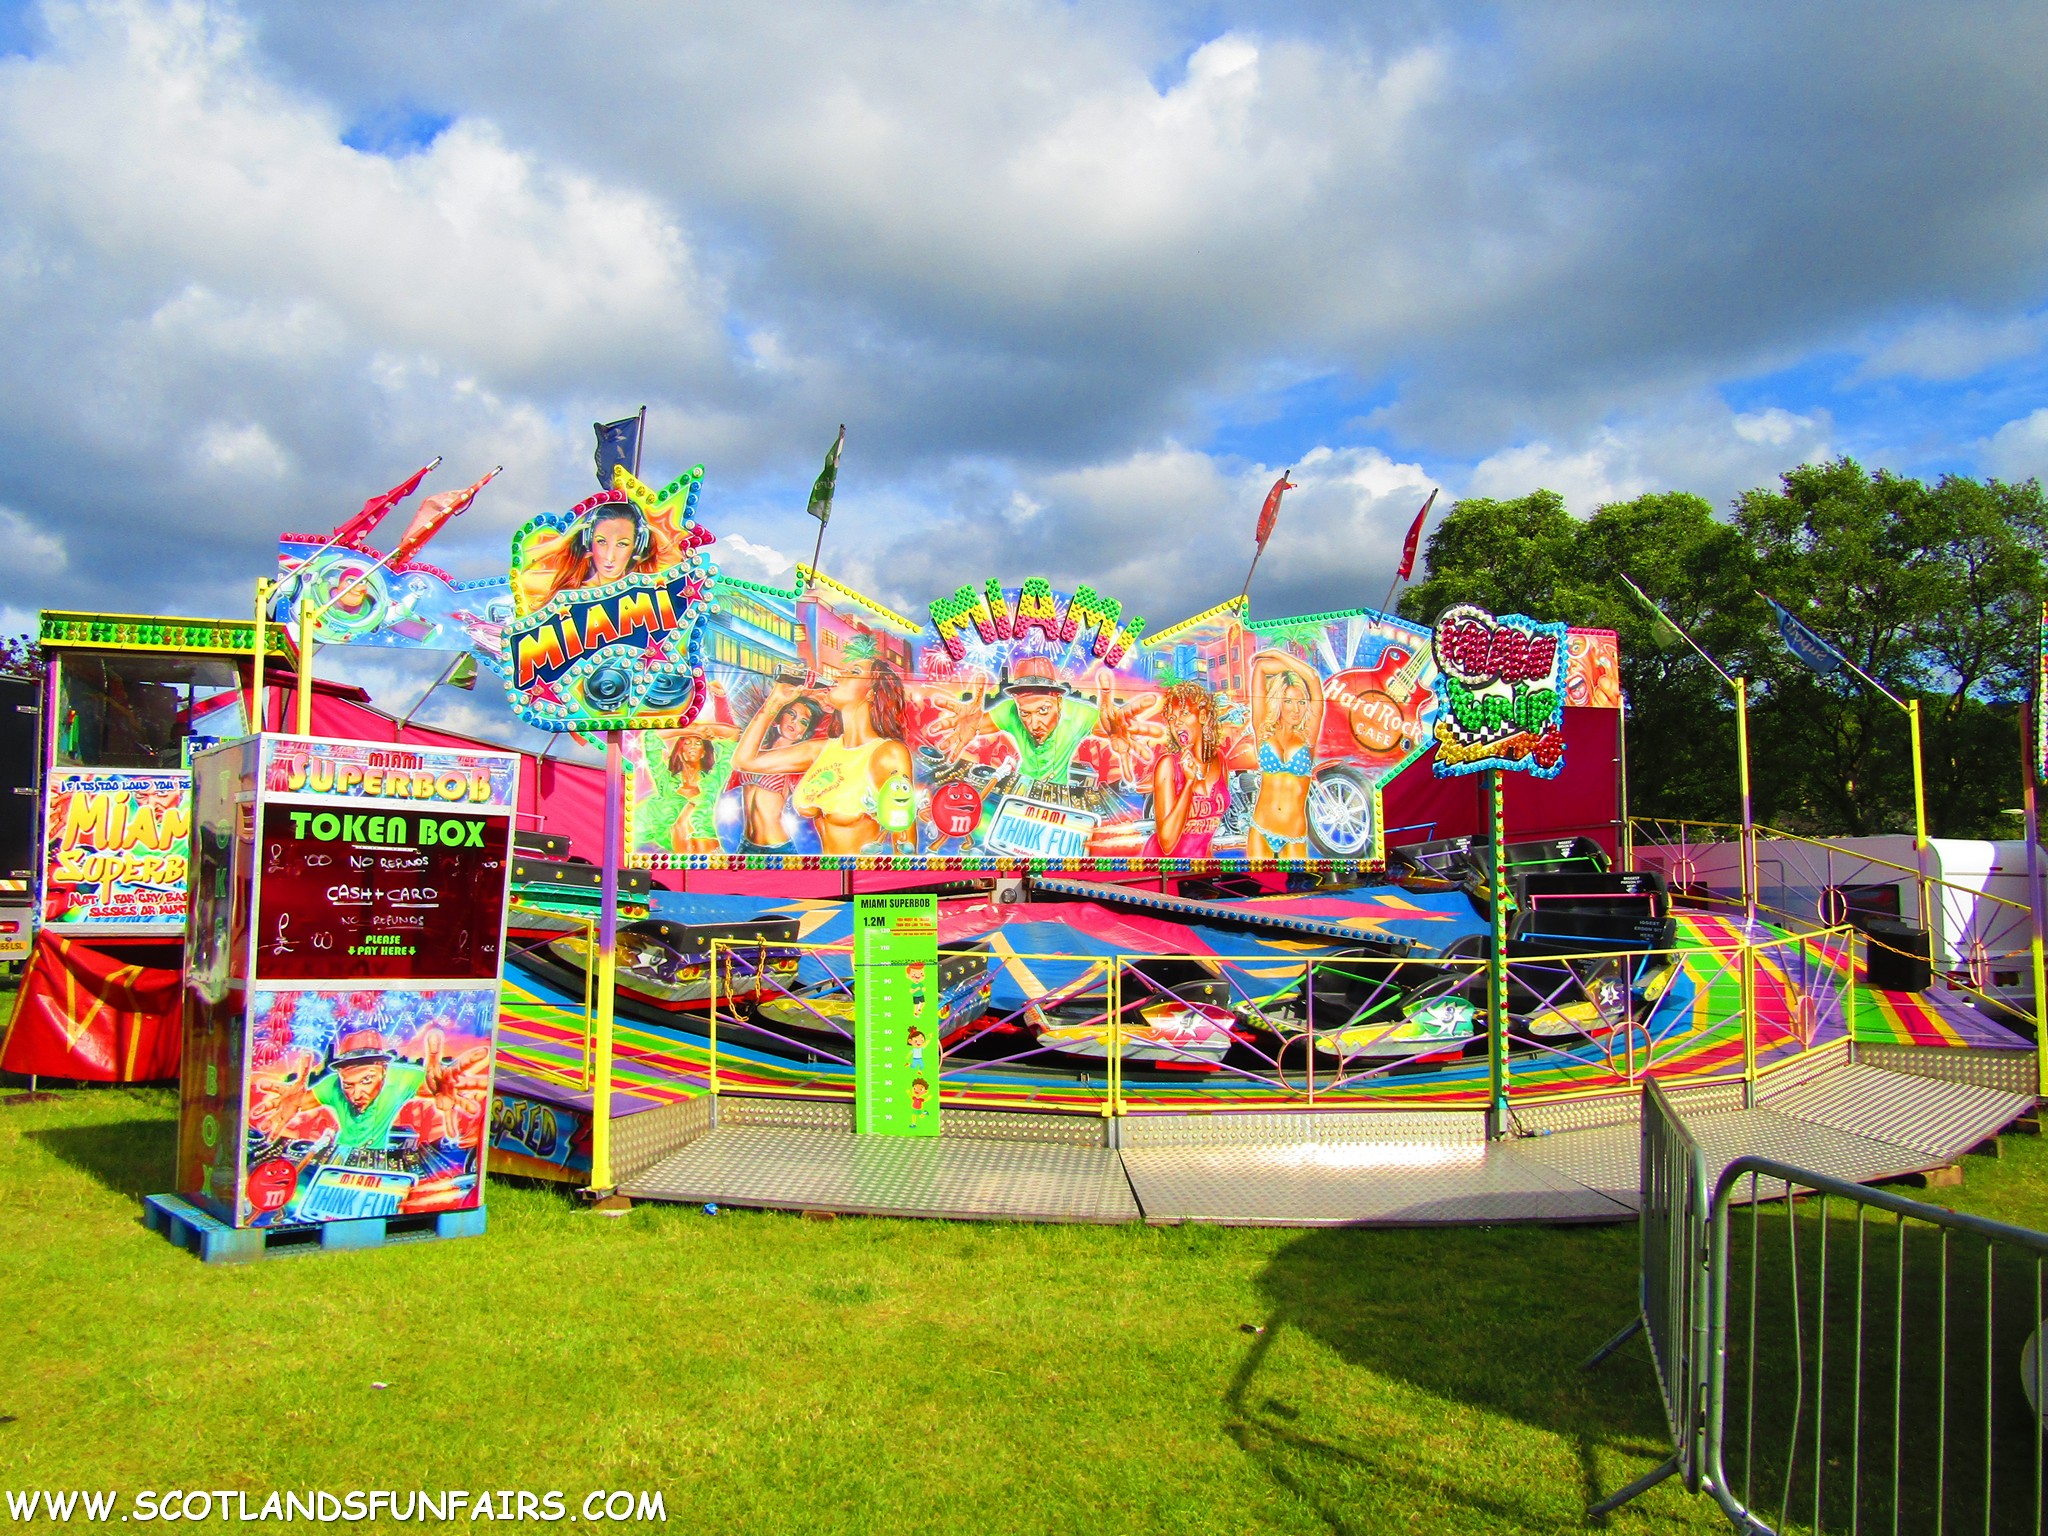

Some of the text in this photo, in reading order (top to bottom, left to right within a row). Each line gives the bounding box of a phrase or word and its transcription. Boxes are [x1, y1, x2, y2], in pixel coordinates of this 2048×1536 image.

[929, 577, 1146, 668] MIAMI
[518, 577, 678, 687] MiAMi
[1322, 678, 1379, 720] Hard
[1356, 722, 1391, 747] CAFE
[368, 752, 423, 769] MIAMI
[122, 782, 150, 790] LOUD
[154, 781, 174, 790] YOU
[288, 752, 492, 802] SUPERBOB
[1024, 805, 1067, 825] MIAMI
[290, 811, 486, 848] TOKEN BOX
[999, 815, 1088, 858] THINK FUN
[350, 856, 374, 868] NO
[113, 893, 135, 904] FOR
[326, 884, 373, 900] CASH
[386, 887, 438, 901] CARD
[861, 898, 930, 908] MIAMI SUPERBOB
[863, 916, 886, 927] 1.2M
[364, 934, 401, 945] PLEASE
[356, 946, 408, 956] PAY HERE
[1442, 1006, 1455, 1023] 3
[491, 1097, 557, 1156] SPEED
[340, 1173, 382, 1188] MIAMI
[311, 1184, 402, 1217] THINK FUN
